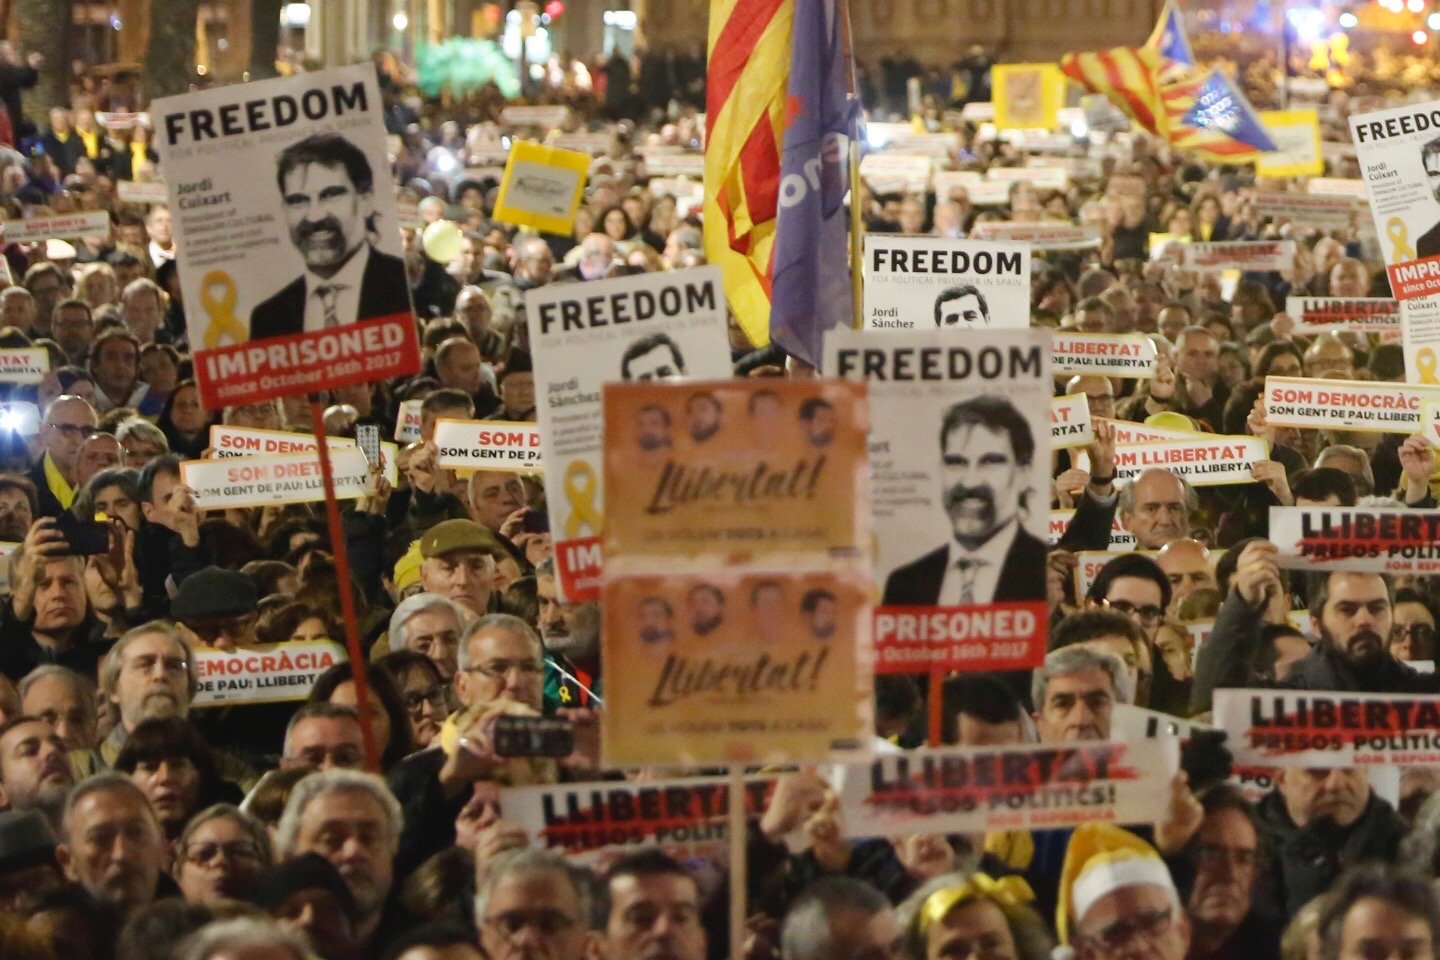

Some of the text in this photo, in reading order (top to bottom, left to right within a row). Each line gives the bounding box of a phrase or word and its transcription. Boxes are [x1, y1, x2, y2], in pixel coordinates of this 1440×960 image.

[165, 81, 368, 145] FREEDOM
[1367, 162, 1387, 174] Jordi
[1369, 170, 1399, 182] Cuixart
[873, 249, 1022, 275] FREEDOM
[1402, 283, 1425, 293] since
[538, 280, 716, 334] FREEDOM
[872, 307, 898, 318] Jordi
[1407, 300, 1438, 311] Cuixart
[206, 321, 405, 380] IMPRISONED
[837, 345, 1042, 381] FREEDOM
[1095, 358, 1153, 368] LLIBERTAT
[217, 380, 258, 398] since
[260, 369, 322, 389] October
[365, 352, 401, 372] 2017
[1271, 388, 1421, 412] SOM DEMOCRÀC
[1269, 405, 1294, 416] SOM
[1297, 407, 1328, 418] GENT
[1330, 409, 1346, 419] DE
[1377, 411, 1421, 423] LLIBERT
[220, 434, 260, 451] SOM
[479, 431, 524, 447] SOM
[440, 447, 469, 458] SOM
[471, 448, 506, 460] GENT
[1142, 445, 1247, 465] LLIBERTAT
[226, 468, 269, 483] SOM
[224, 484, 254, 496] GENT
[875, 610, 1036, 642] PRISONED
[256, 675, 315, 688] LLIBERT
